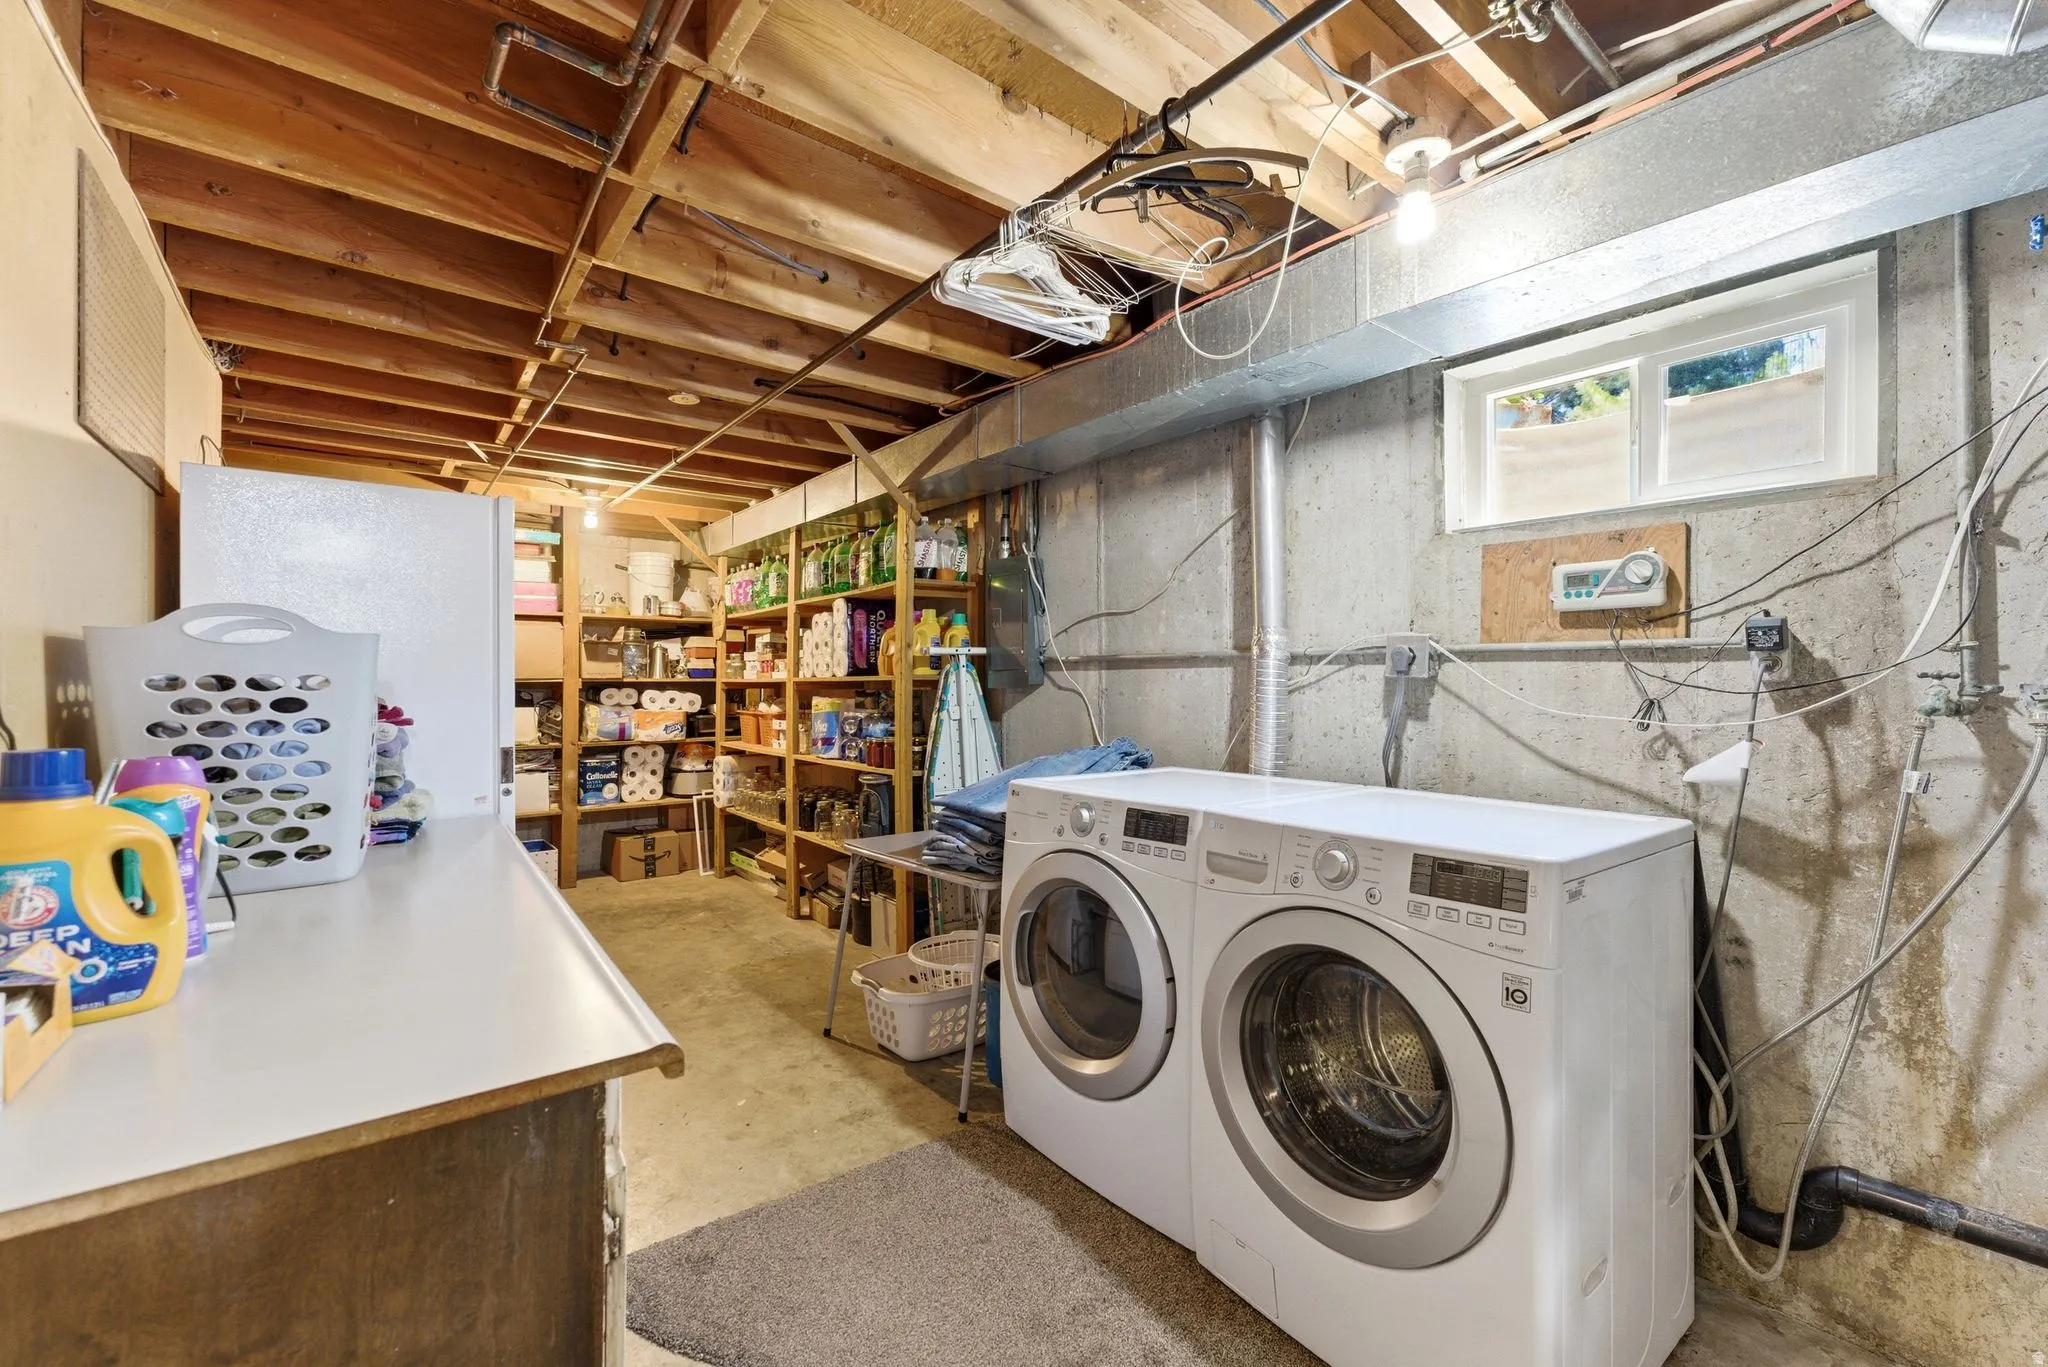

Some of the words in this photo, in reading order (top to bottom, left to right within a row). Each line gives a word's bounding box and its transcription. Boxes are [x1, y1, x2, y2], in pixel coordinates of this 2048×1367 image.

[916, 538, 933, 568] SHASTA
[869, 615, 877, 663] NORTHERN
[1505, 986, 1528, 1005] 10
